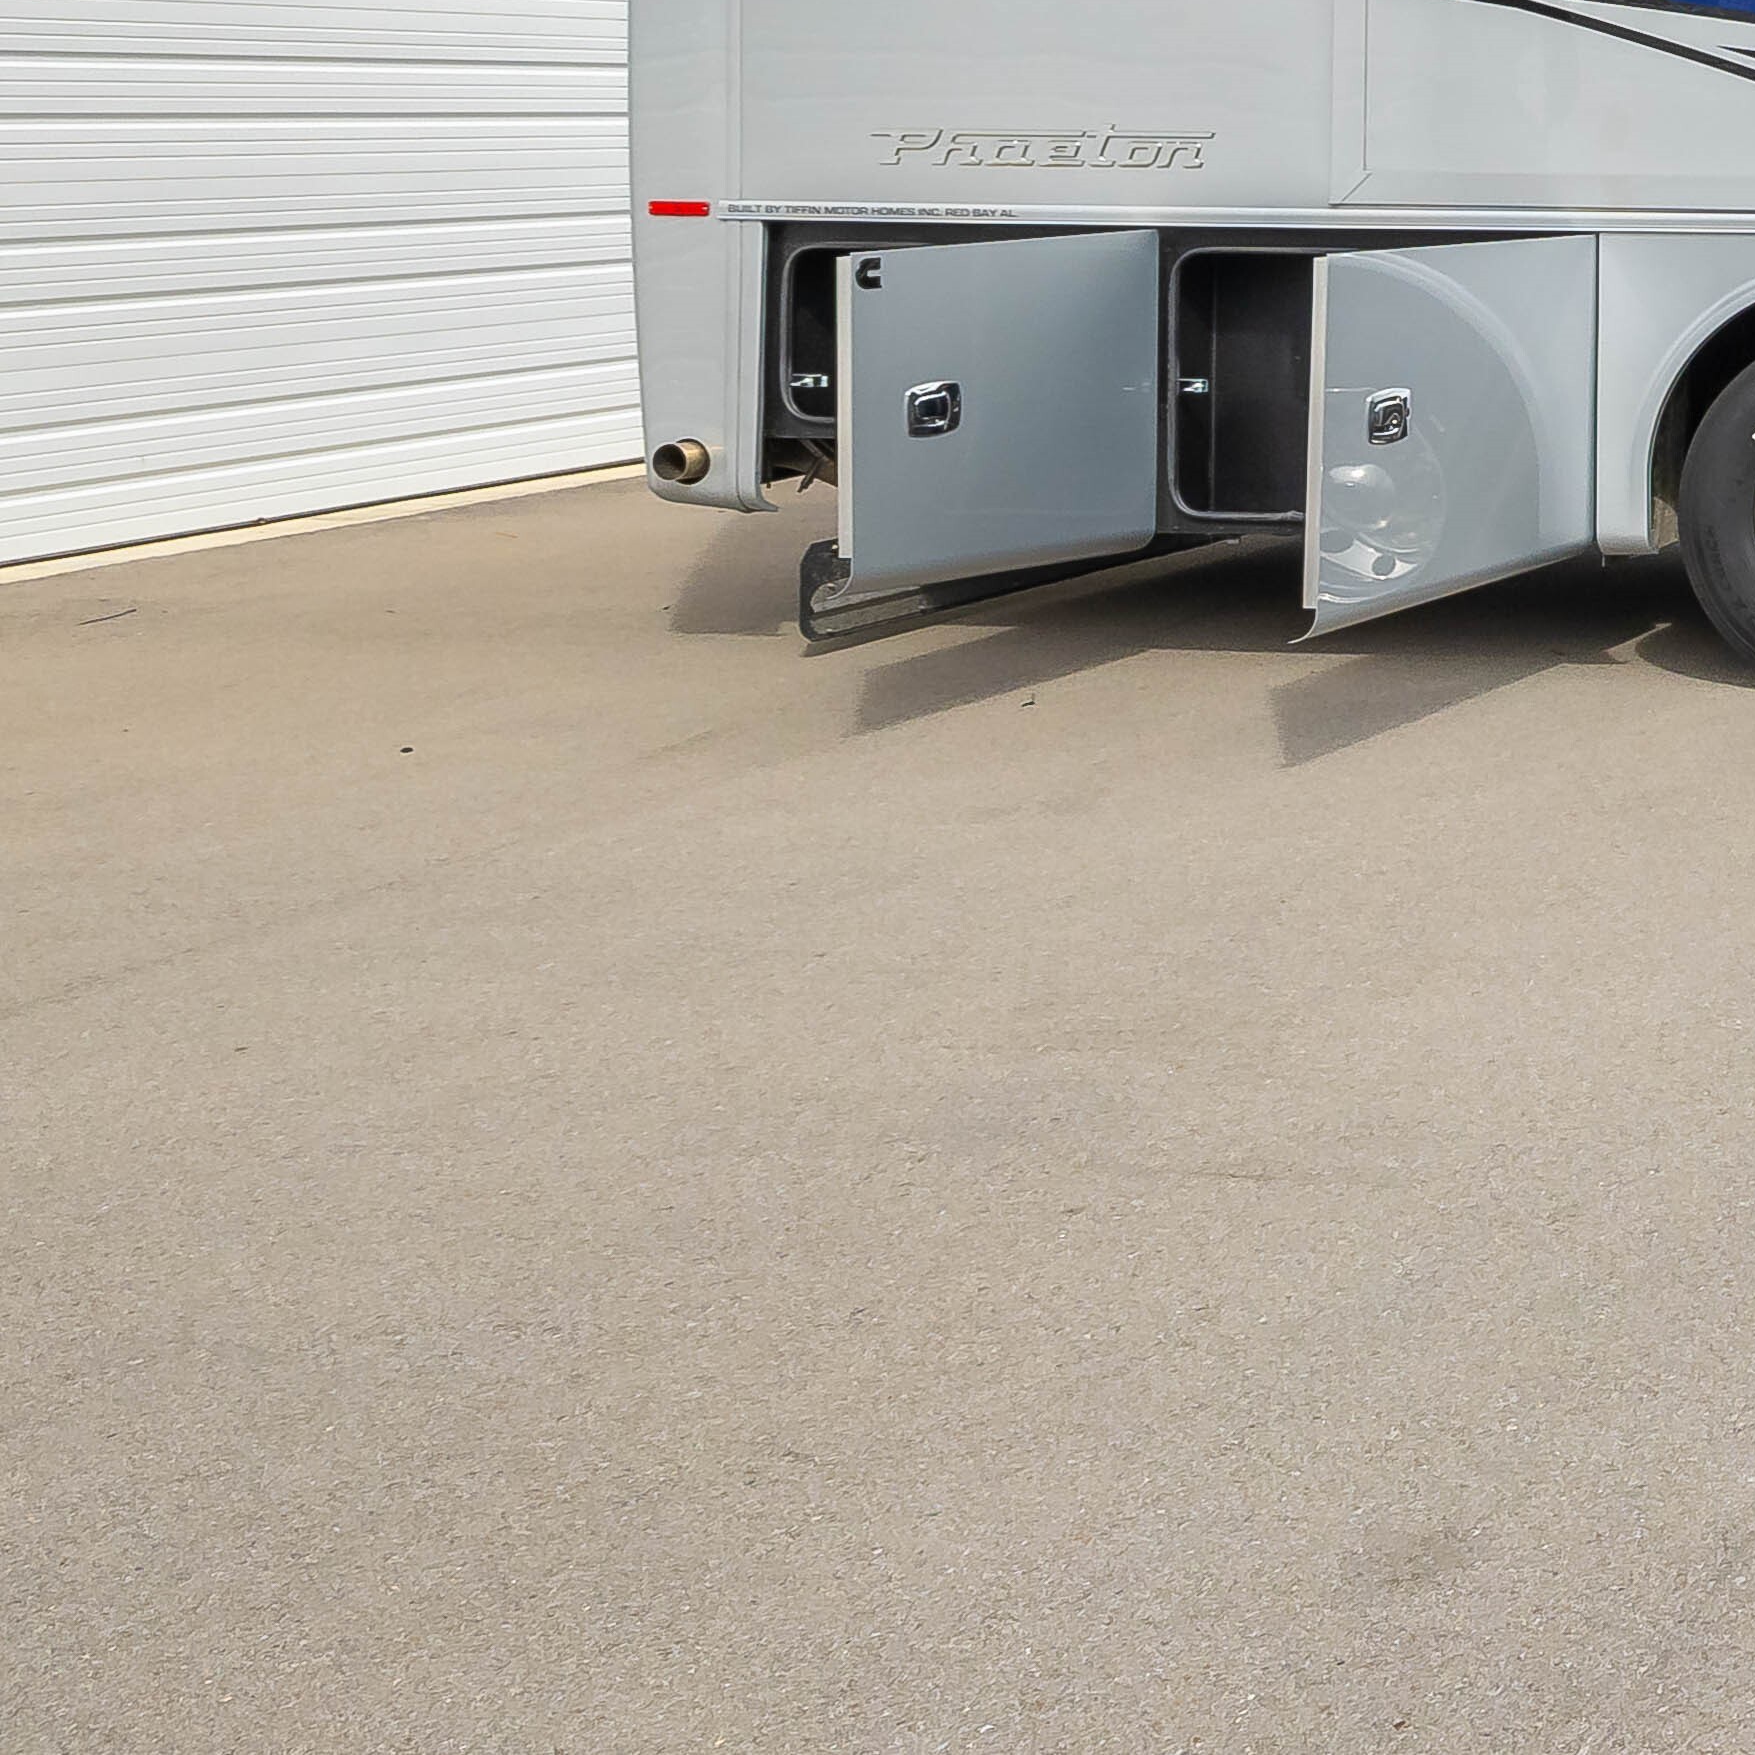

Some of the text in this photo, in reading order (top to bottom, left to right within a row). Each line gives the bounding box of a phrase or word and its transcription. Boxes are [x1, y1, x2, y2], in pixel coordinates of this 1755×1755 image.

[728, 204, 762, 213] BUILT
[765, 205, 783, 213] BY
[784, 205, 821, 214] TIFFIN
[824, 206, 868, 215] MOTOR
[871, 207, 916, 216] HOMES
[945, 208, 970, 217] RED
[972, 208, 997, 217] BAY
